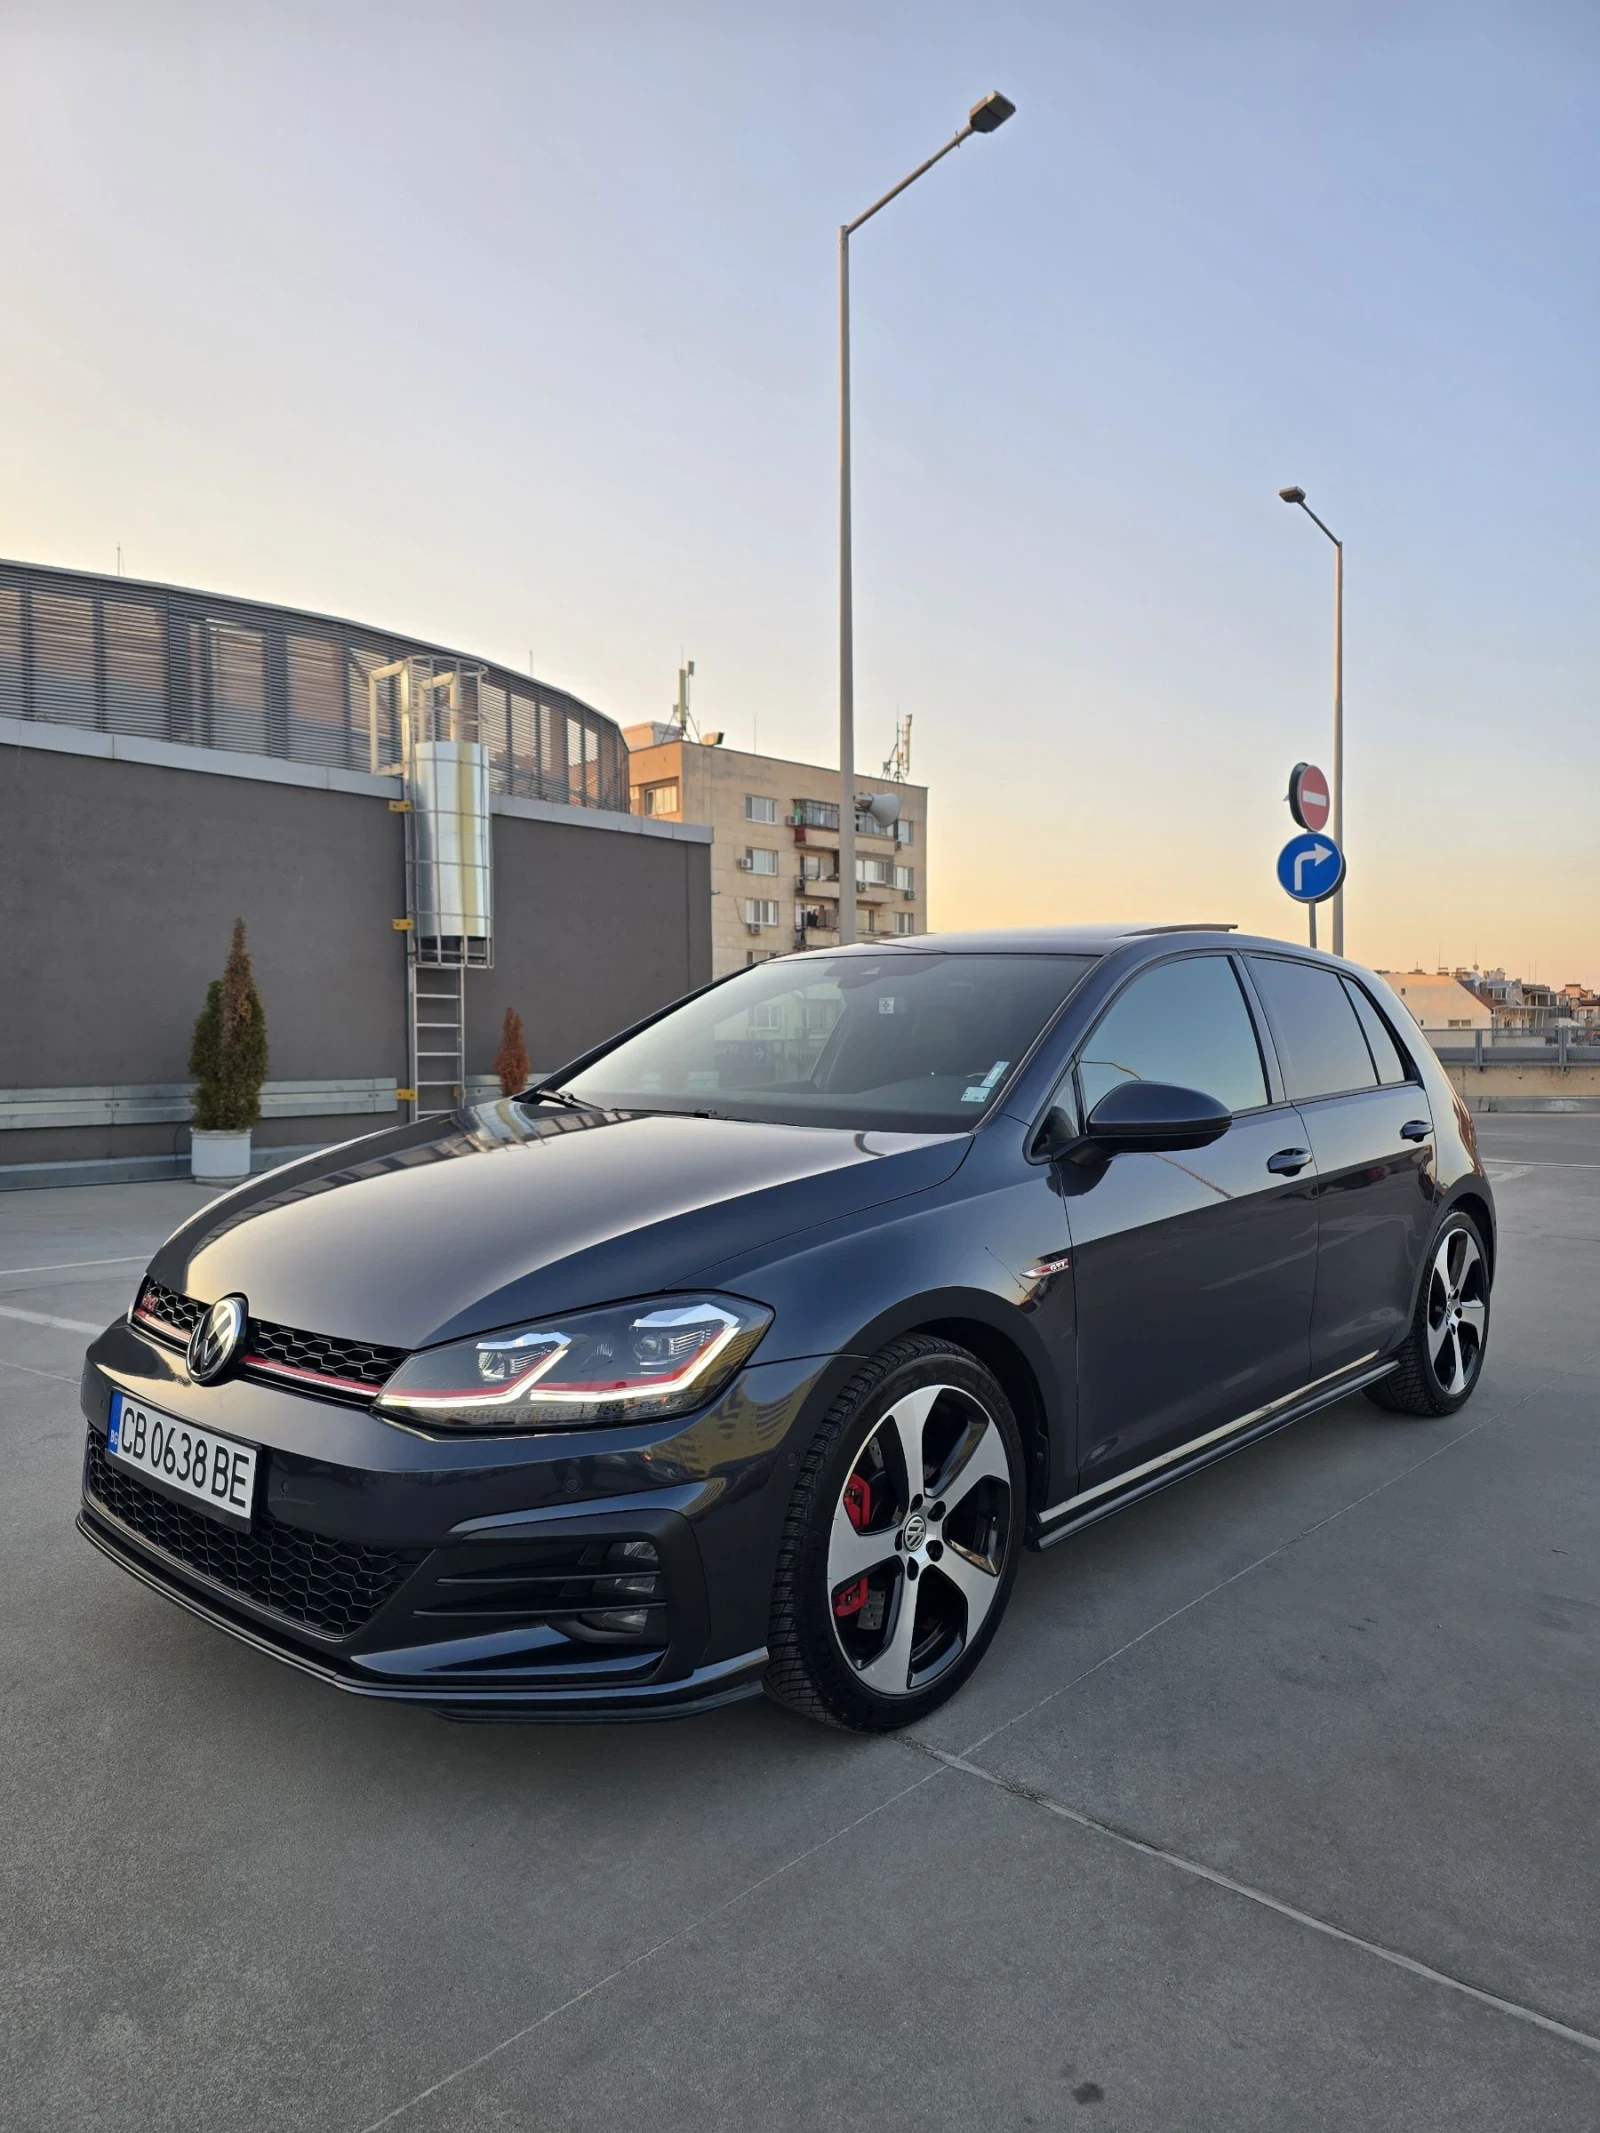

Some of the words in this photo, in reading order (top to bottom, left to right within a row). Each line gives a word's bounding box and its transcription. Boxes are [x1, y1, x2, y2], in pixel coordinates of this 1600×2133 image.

[109, 1429, 119, 1445] BG
[121, 1406, 147, 1460] CB
[151, 1420, 208, 1488] 0638
[211, 1444, 250, 1508] BE
